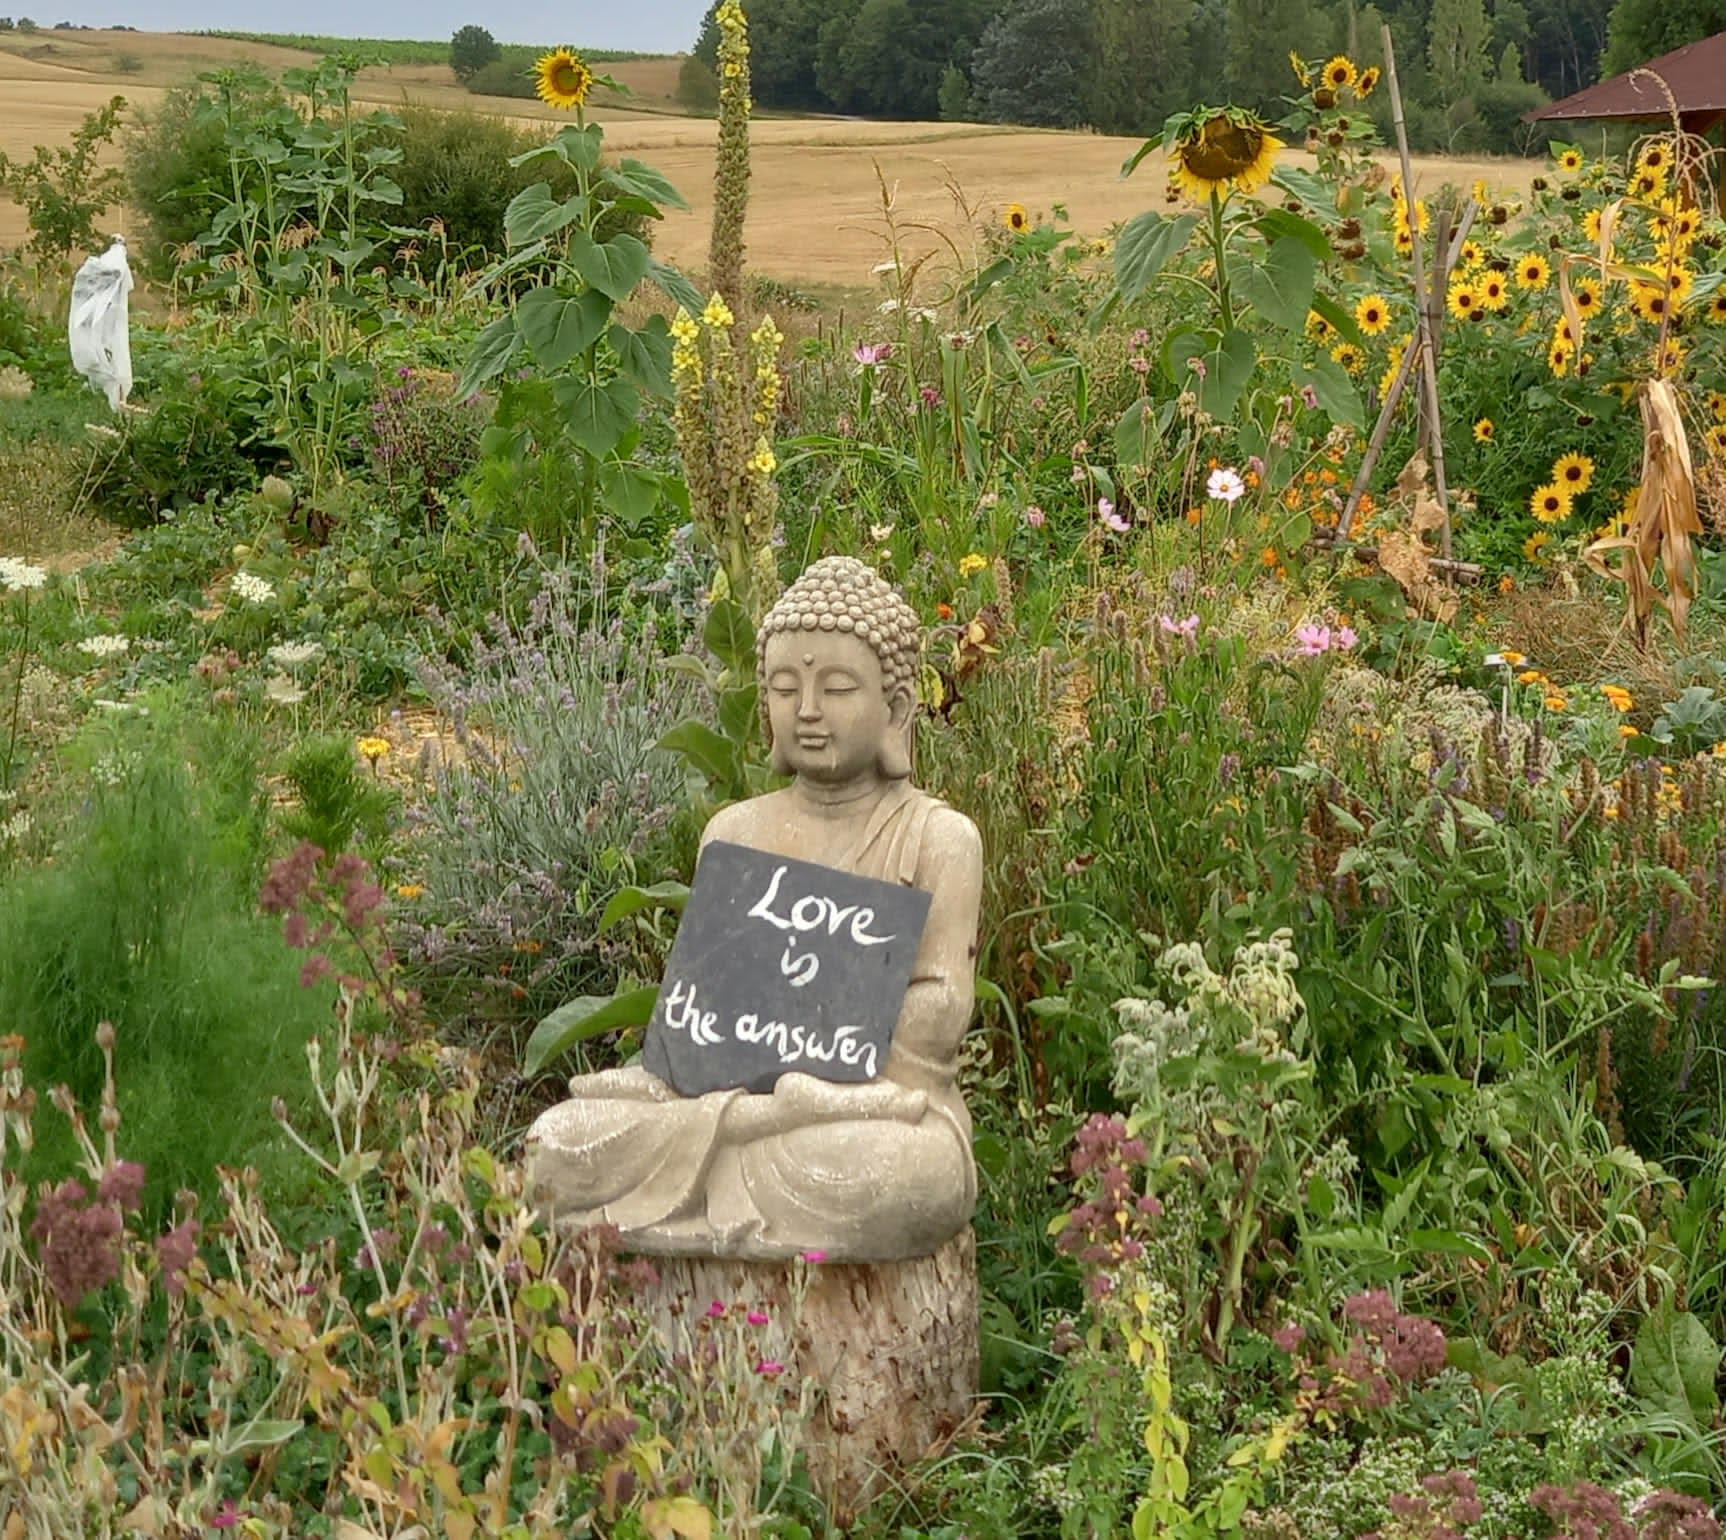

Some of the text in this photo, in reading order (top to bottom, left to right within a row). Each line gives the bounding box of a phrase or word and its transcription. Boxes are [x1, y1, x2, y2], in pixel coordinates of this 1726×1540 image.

[747, 866, 896, 946] Love
[780, 935, 820, 987] is
[664, 980, 877, 1079] the answer
